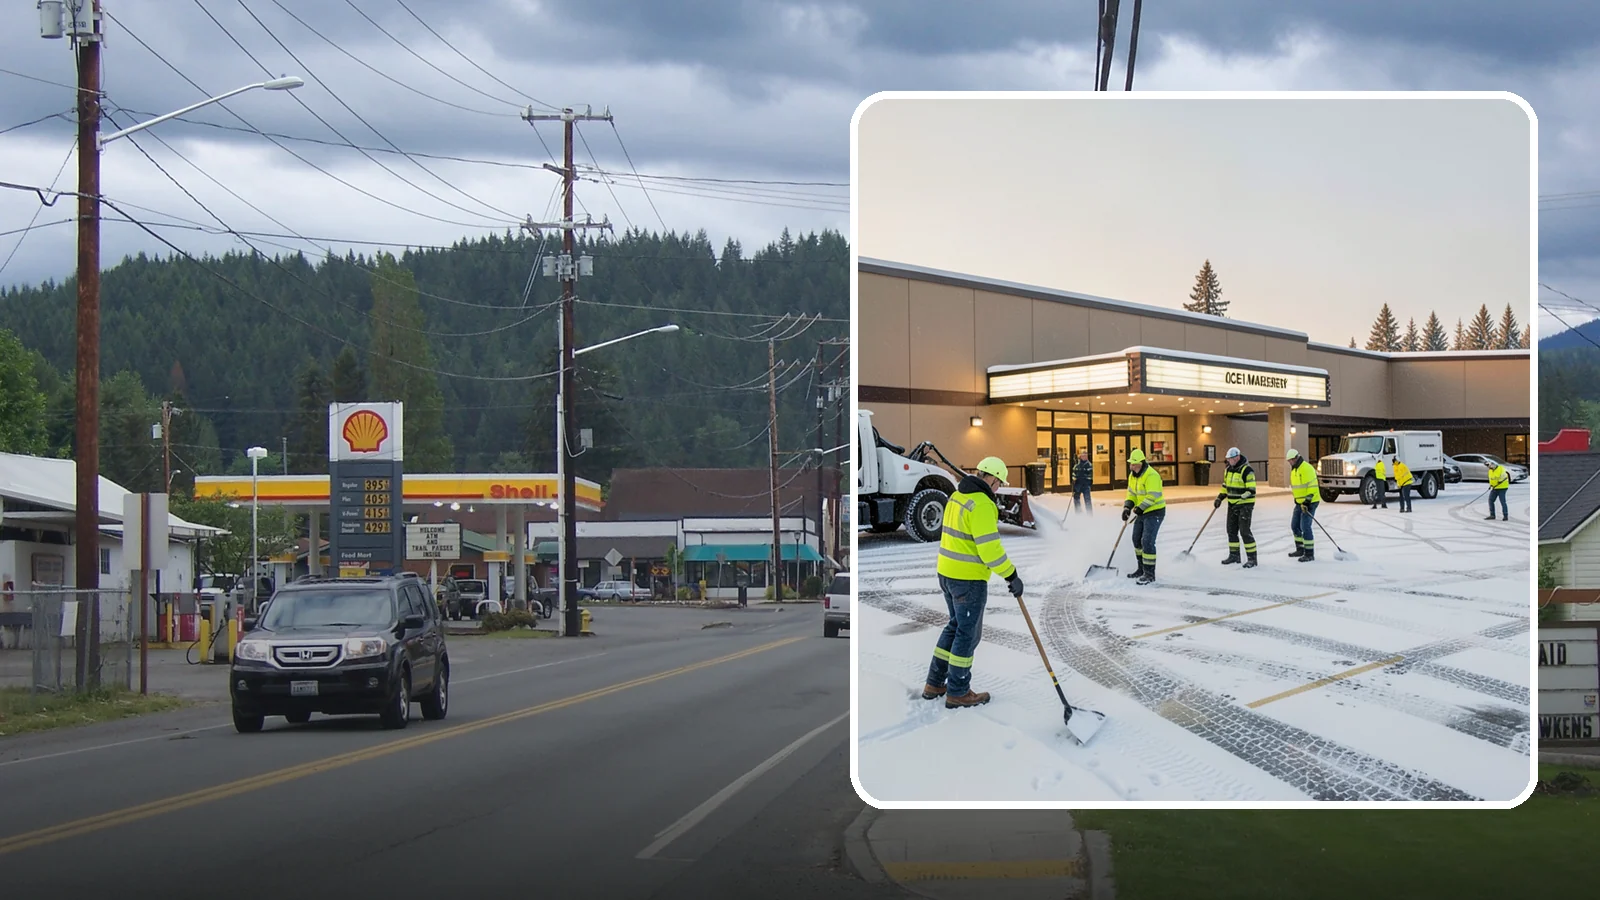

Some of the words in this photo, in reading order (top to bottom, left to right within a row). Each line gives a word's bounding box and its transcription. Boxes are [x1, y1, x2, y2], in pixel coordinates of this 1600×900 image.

[366, 480, 383, 490] 395
[490, 484, 547, 499] Shell
[366, 494, 383, 504] 405
[366, 508, 383, 518] 415
[366, 522, 383, 532] 429
